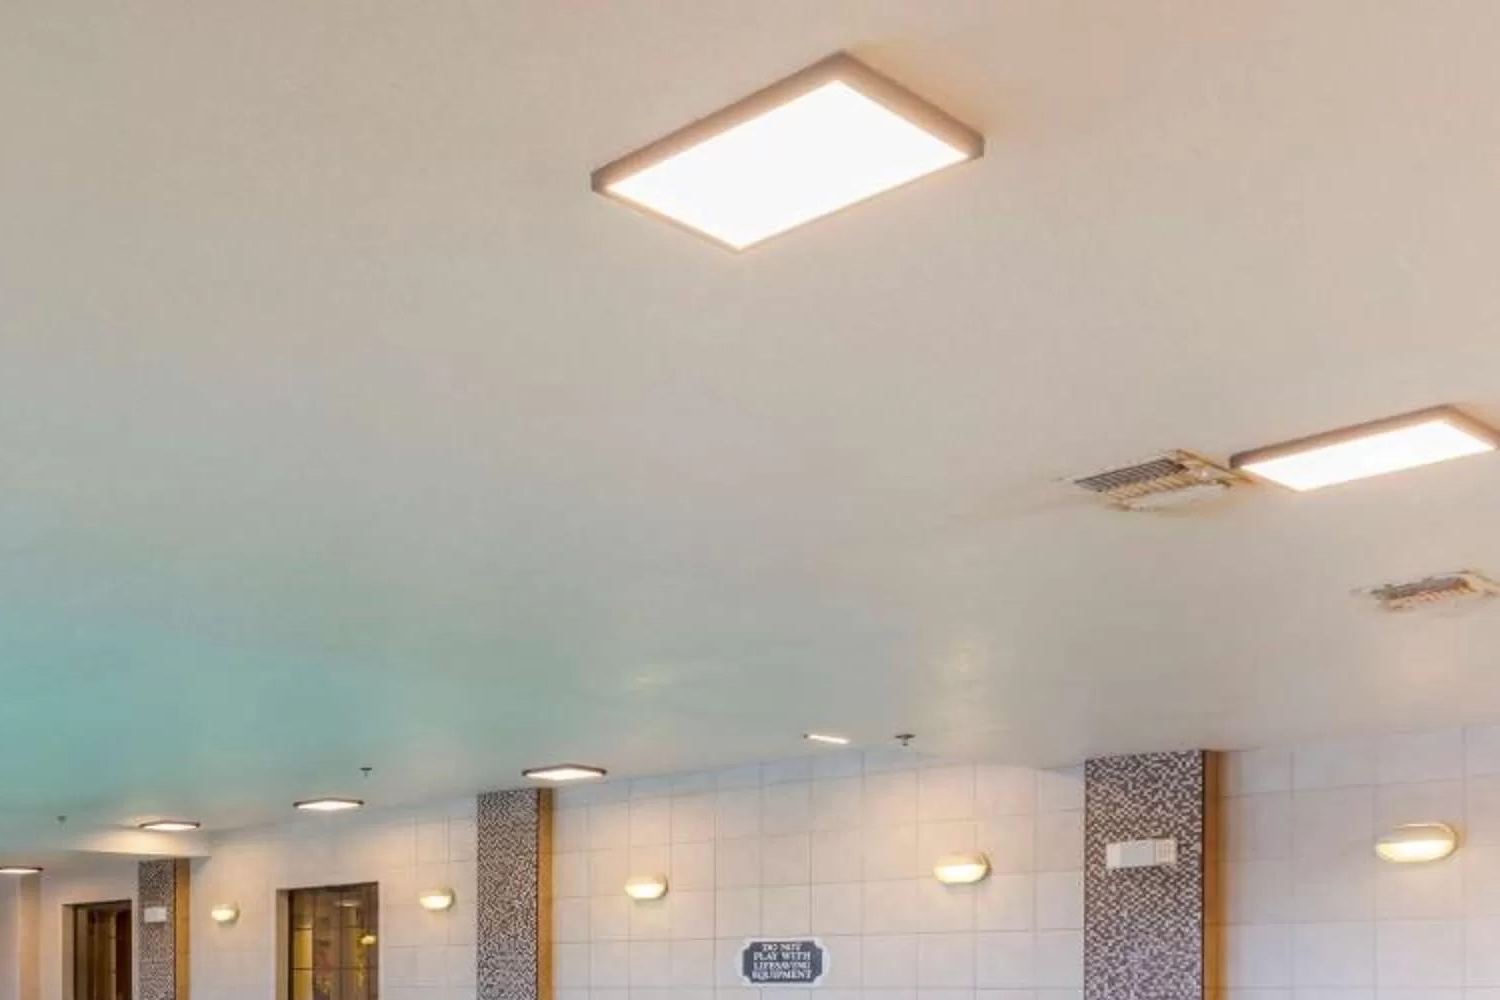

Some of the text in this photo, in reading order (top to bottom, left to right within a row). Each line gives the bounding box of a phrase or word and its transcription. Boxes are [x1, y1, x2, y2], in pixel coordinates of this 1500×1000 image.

[762, 943, 802, 952] DO NOT
[753, 951, 811, 961] PLAY WITH
[753, 961, 812, 970] LIFESAVING
[751, 970, 812, 980] EQUIPMENT
